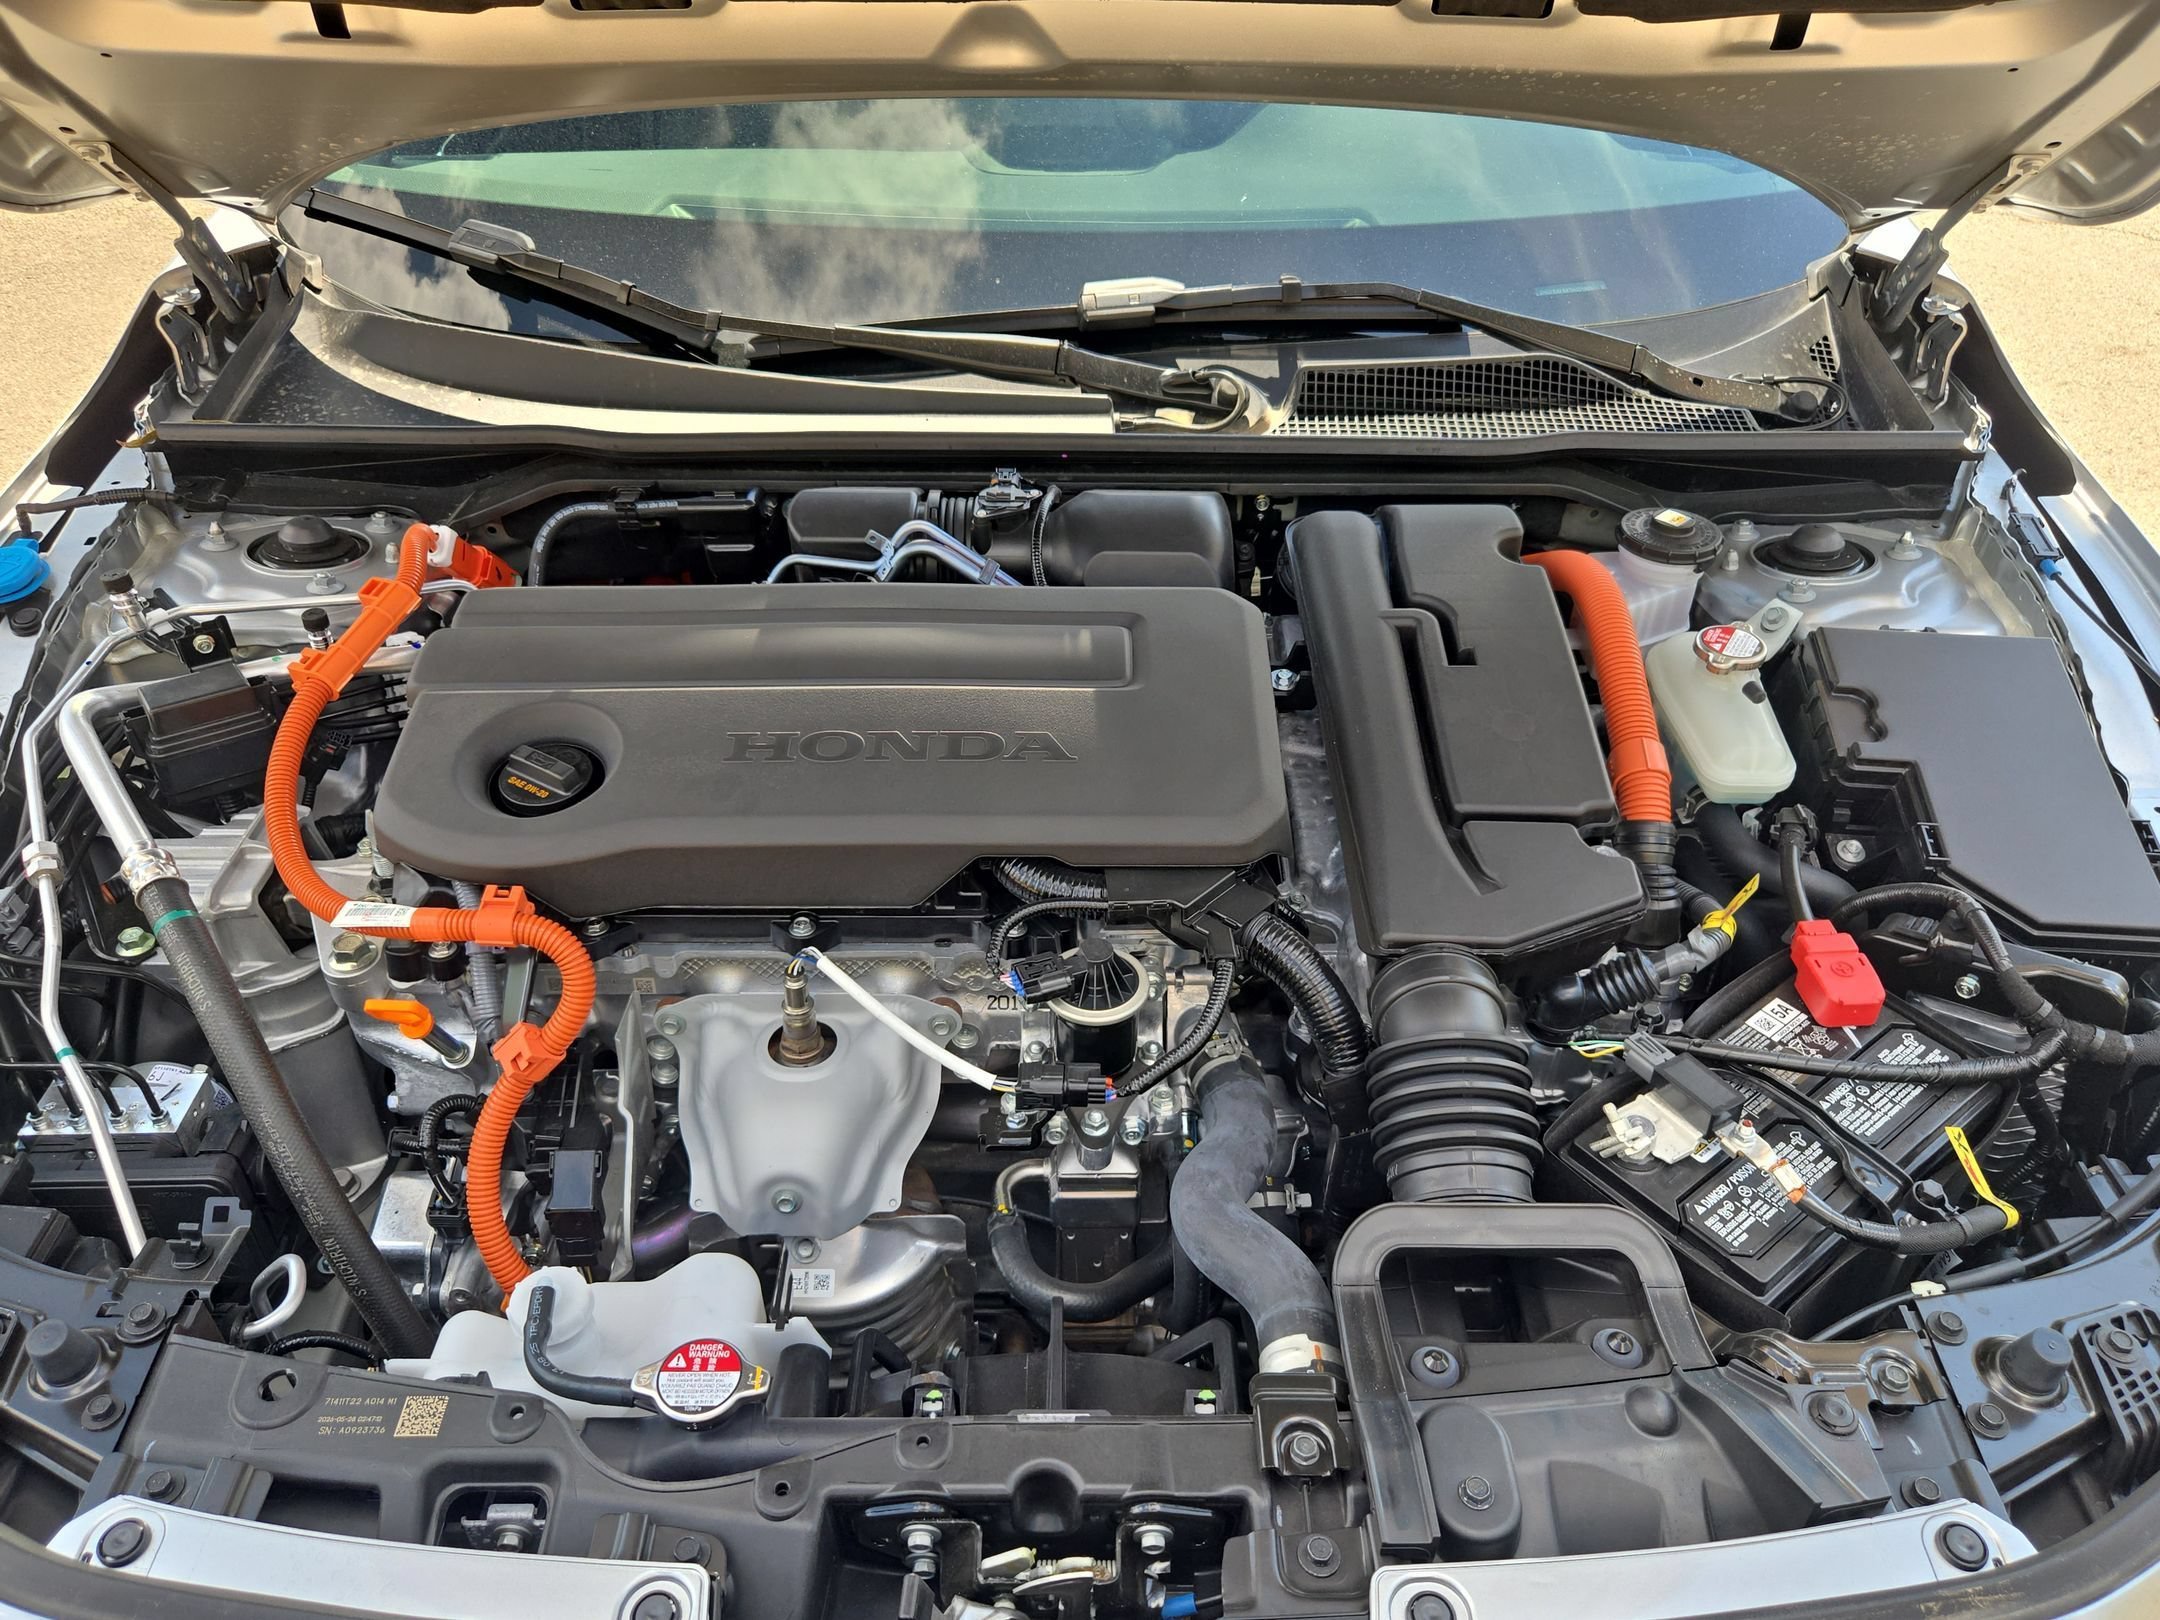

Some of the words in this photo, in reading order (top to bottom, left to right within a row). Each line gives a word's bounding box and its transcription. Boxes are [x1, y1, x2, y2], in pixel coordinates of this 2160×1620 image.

[721, 730, 1079, 763] HONDA
[507, 776, 528, 788] SAE
[523, 784, 550, 799] 0W-20
[1770, 1003, 1794, 1019] 5A
[688, 1350, 730, 1358] WARNUNG
[318, 1427, 337, 1435] SN:
[339, 1426, 386, 1435] A0923736
